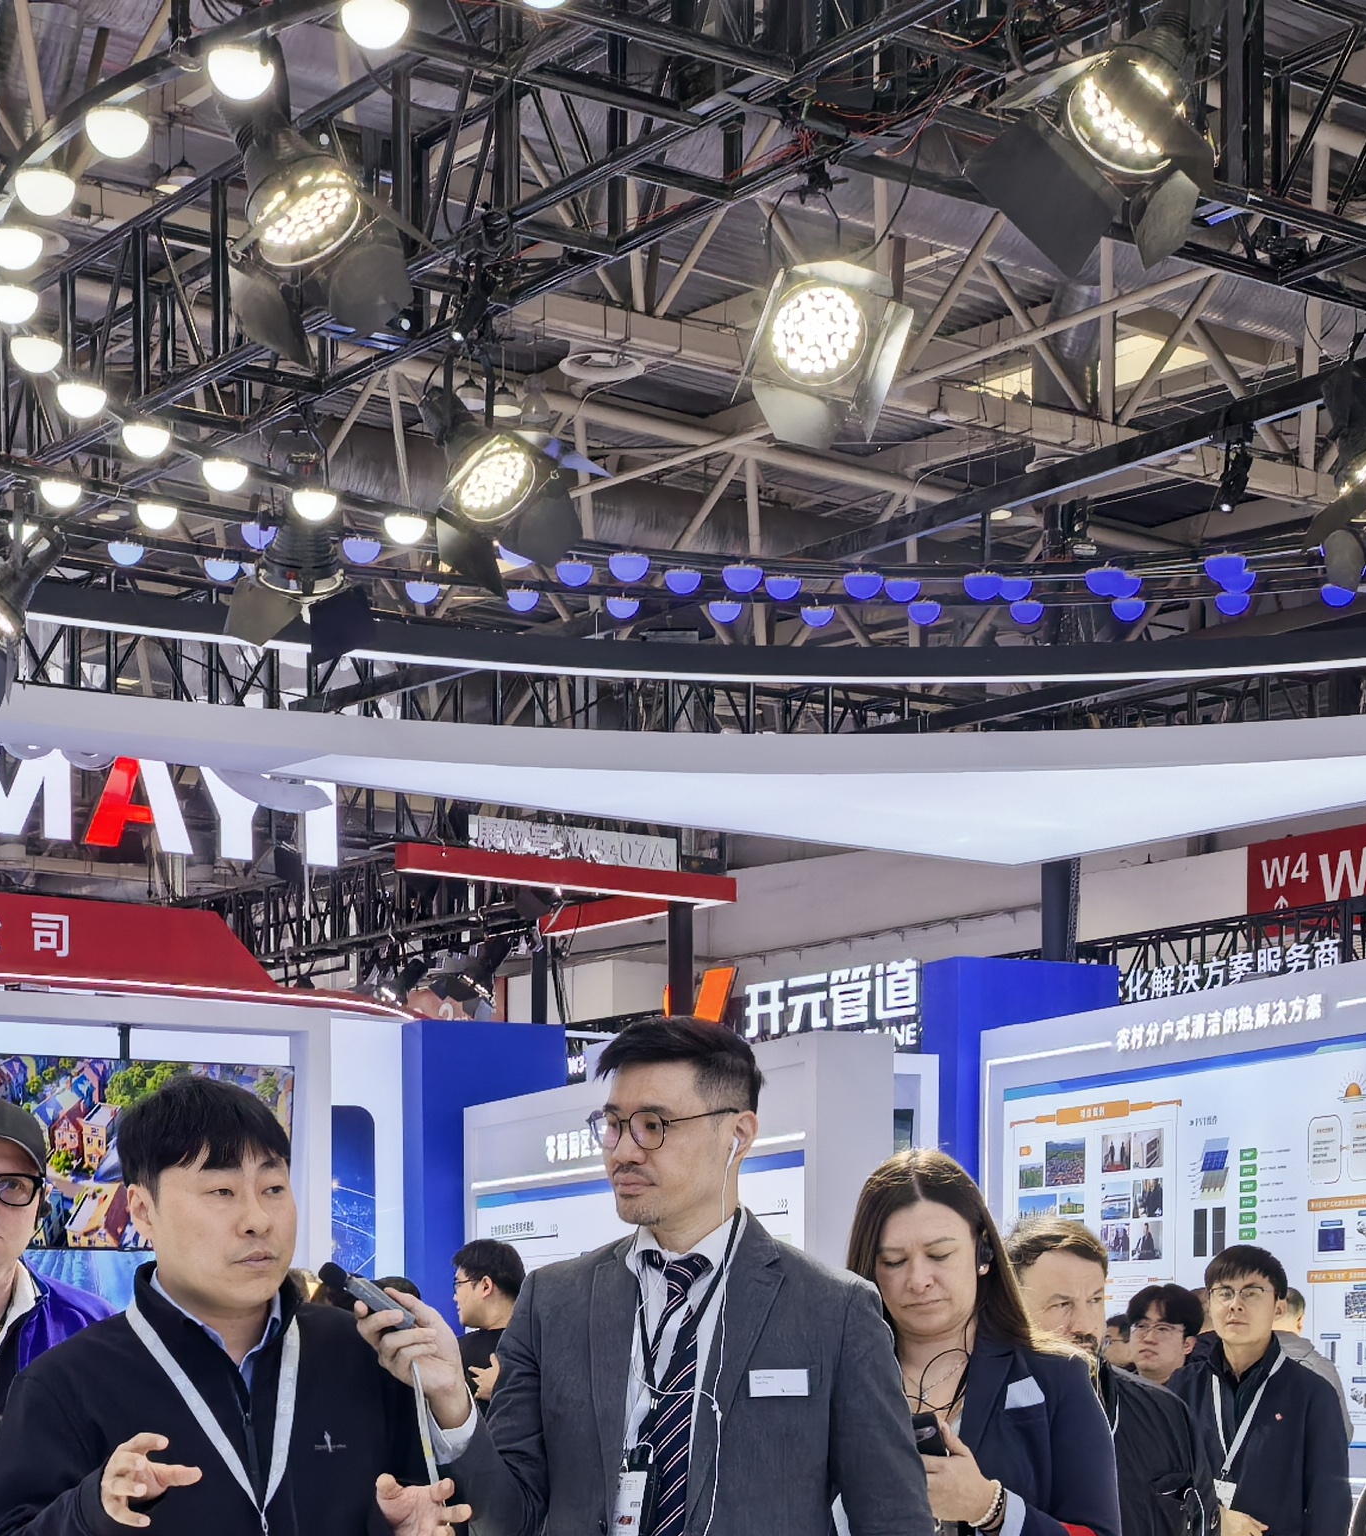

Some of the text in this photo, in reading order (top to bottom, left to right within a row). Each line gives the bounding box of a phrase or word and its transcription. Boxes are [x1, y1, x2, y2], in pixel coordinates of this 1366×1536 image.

[1261, 852, 1310, 890] W4
[745, 958, 918, 1040] 开元管道
[1115, 992, 1323, 1053] 农村分户式清洁供热解决方案
